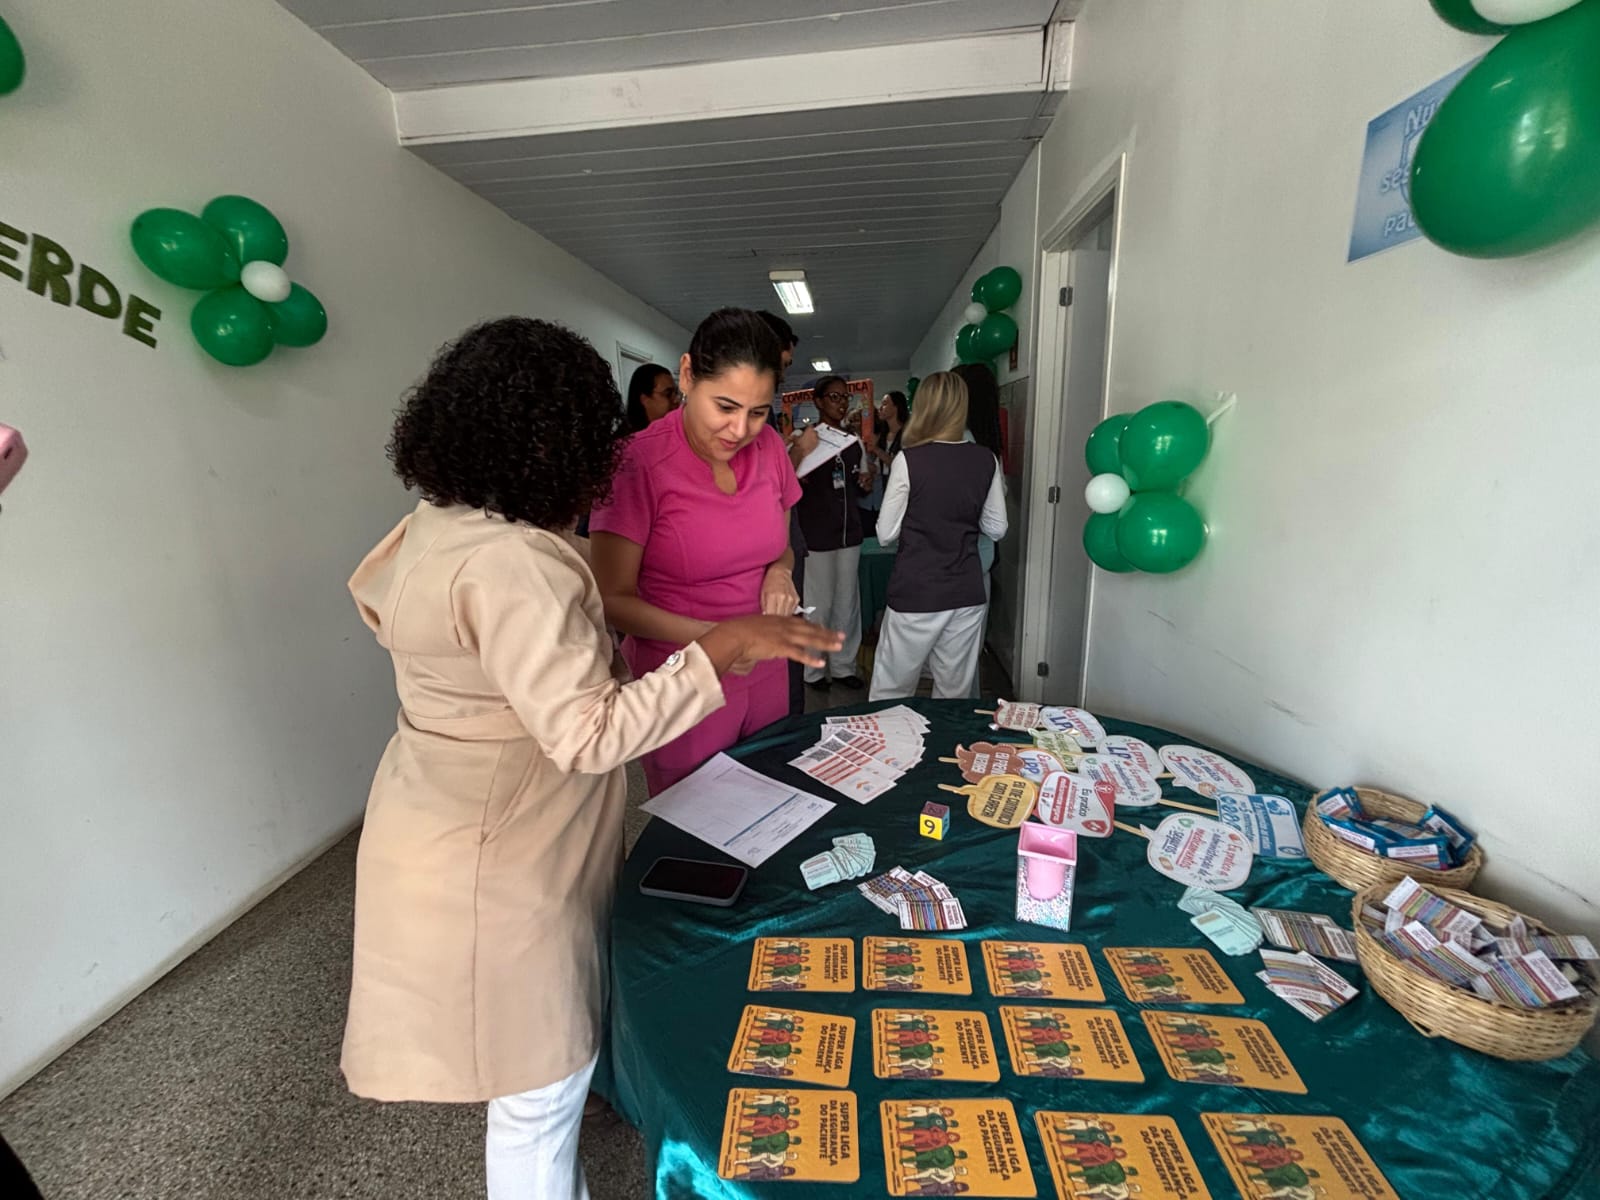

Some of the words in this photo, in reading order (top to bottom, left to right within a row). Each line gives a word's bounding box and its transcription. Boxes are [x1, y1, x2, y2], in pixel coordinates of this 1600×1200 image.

[1082, 788, 1092, 796] Eu
[1079, 796, 1090, 817] pratico
[820, 1025, 828, 1035] DO
[831, 1023, 837, 1031] DA
[955, 1021, 963, 1030] DO
[963, 1018, 970, 1027] DA
[837, 1025, 847, 1049] SUPER
[958, 1031, 970, 1064] PACIENTE
[972, 1020, 984, 1044] SUPER
[978, 1046, 990, 1064] LIGA
[816, 1036, 827, 1067] PACIENTE
[834, 1051, 844, 1069] LIGA
[820, 1104, 827, 1115] DO
[830, 1100, 837, 1110] DA
[986, 1110, 995, 1121] DA
[840, 1102, 849, 1132] SUPER
[977, 1114, 987, 1127] DO
[819, 1117, 827, 1159] PACIENTE
[997, 1111, 1013, 1144] SUPER
[1007, 1147, 1021, 1173] LIGA
[1148, 1126, 1159, 1138] DA
[840, 1135, 850, 1159] LIGA
[981, 1129, 1000, 1173] PACIENTE
[1140, 1130, 1152, 1144] DO
[1147, 1146, 1173, 1192] PACIENTE
[1161, 1128, 1184, 1163] SUPER
[1178, 1166, 1198, 1193] LIGA
